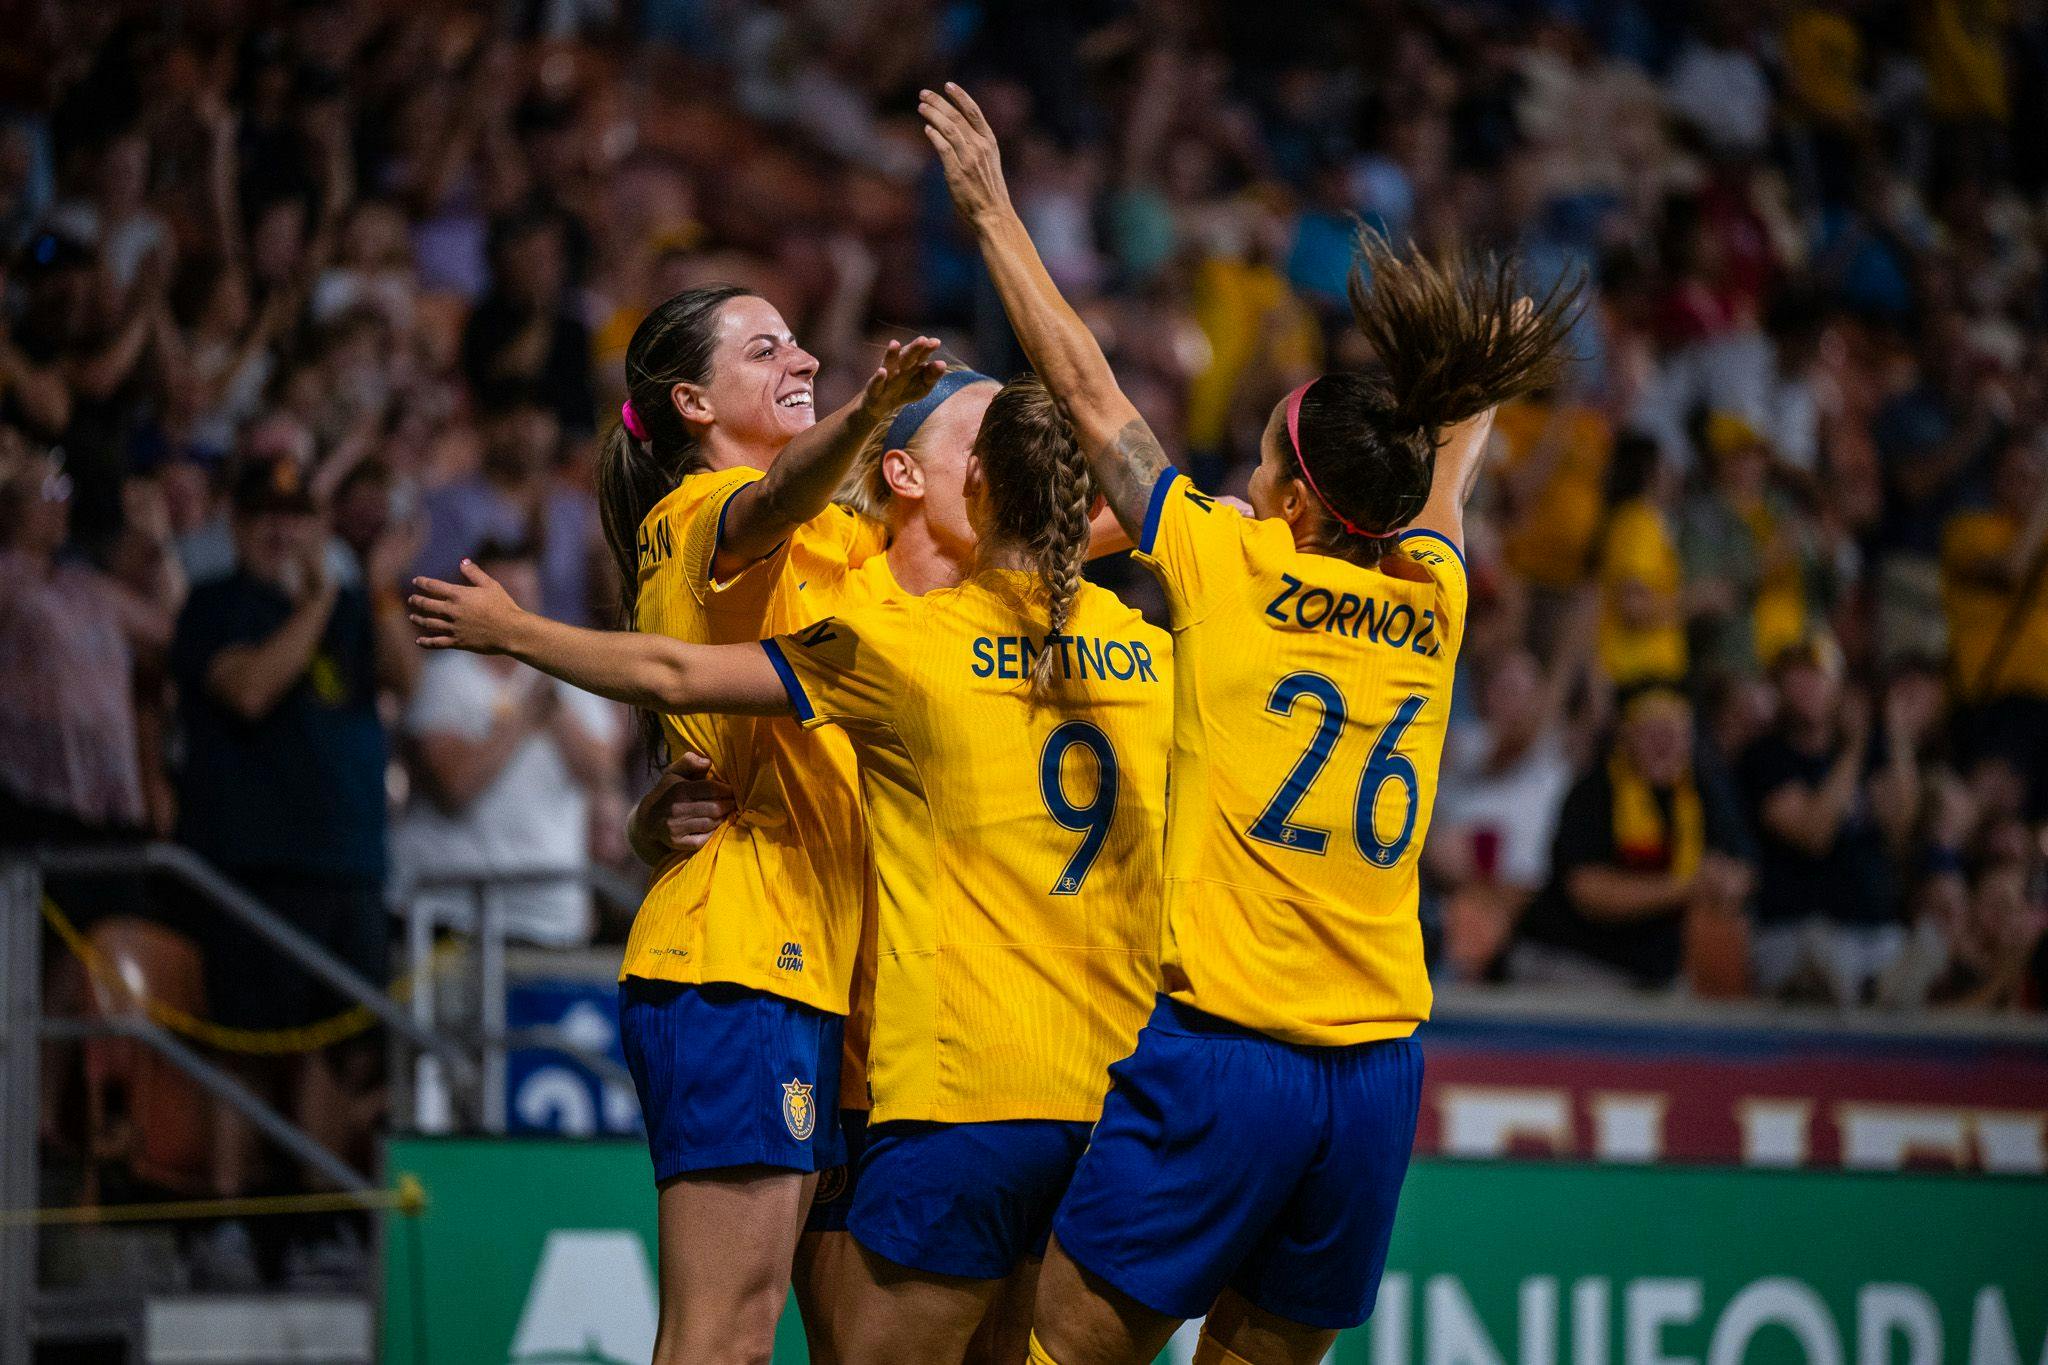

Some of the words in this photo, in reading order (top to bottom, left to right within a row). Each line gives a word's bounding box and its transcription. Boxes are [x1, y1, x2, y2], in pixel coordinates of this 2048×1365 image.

[1265, 572, 1442, 657] ZORNOZ
[971, 635, 1159, 683] SENTNOR
[1038, 719, 1120, 896] 9
[1244, 669, 1430, 870] 26
[777, 956, 804, 972] UTAH
